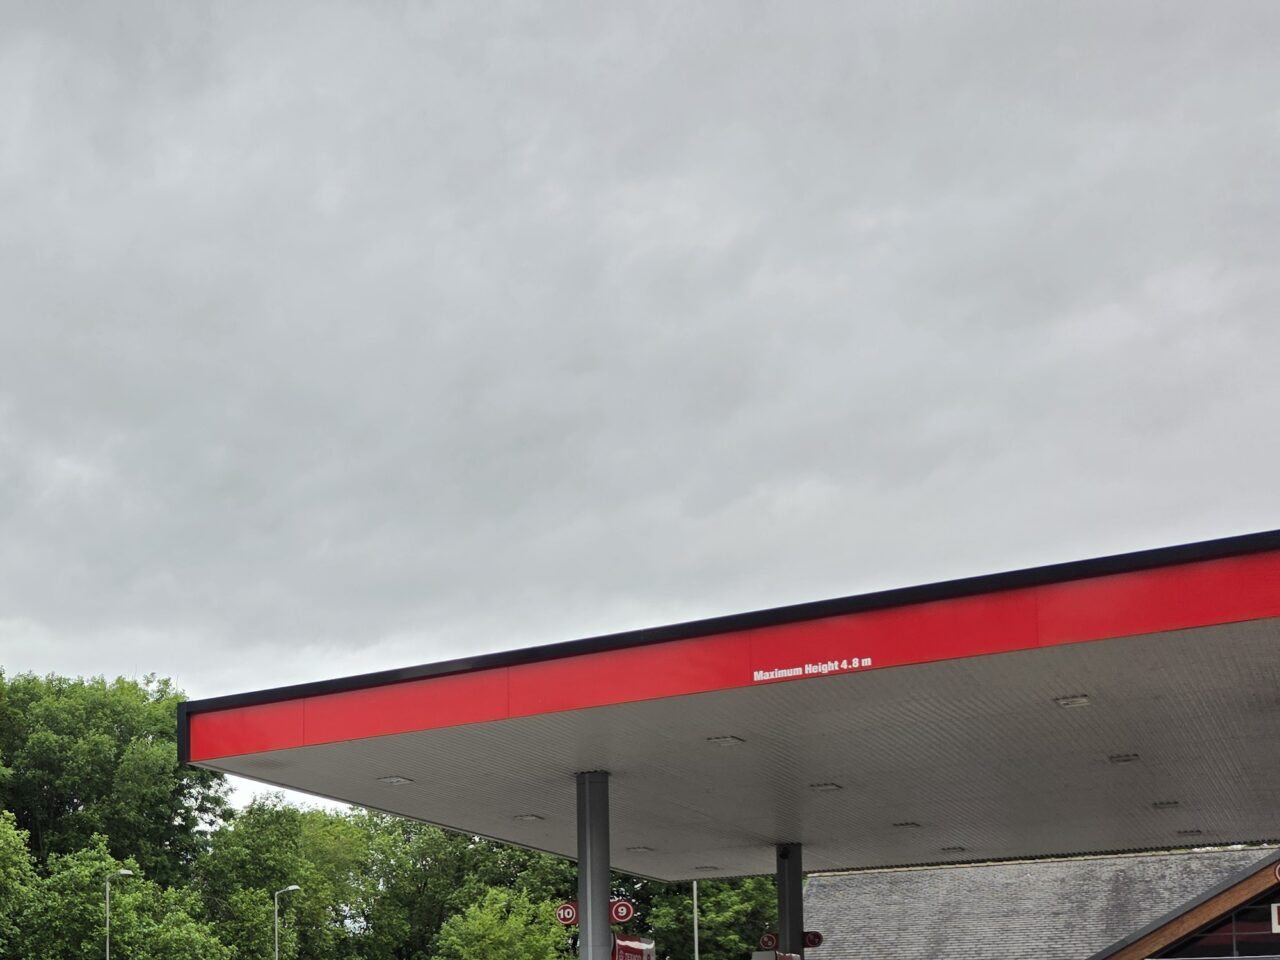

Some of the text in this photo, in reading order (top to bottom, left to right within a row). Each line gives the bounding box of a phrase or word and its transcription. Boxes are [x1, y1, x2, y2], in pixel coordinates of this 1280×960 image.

[753, 657, 872, 681] Maximum Height 4.8 m
[558, 909, 573, 919] 10
[617, 906, 627, 916] 9
